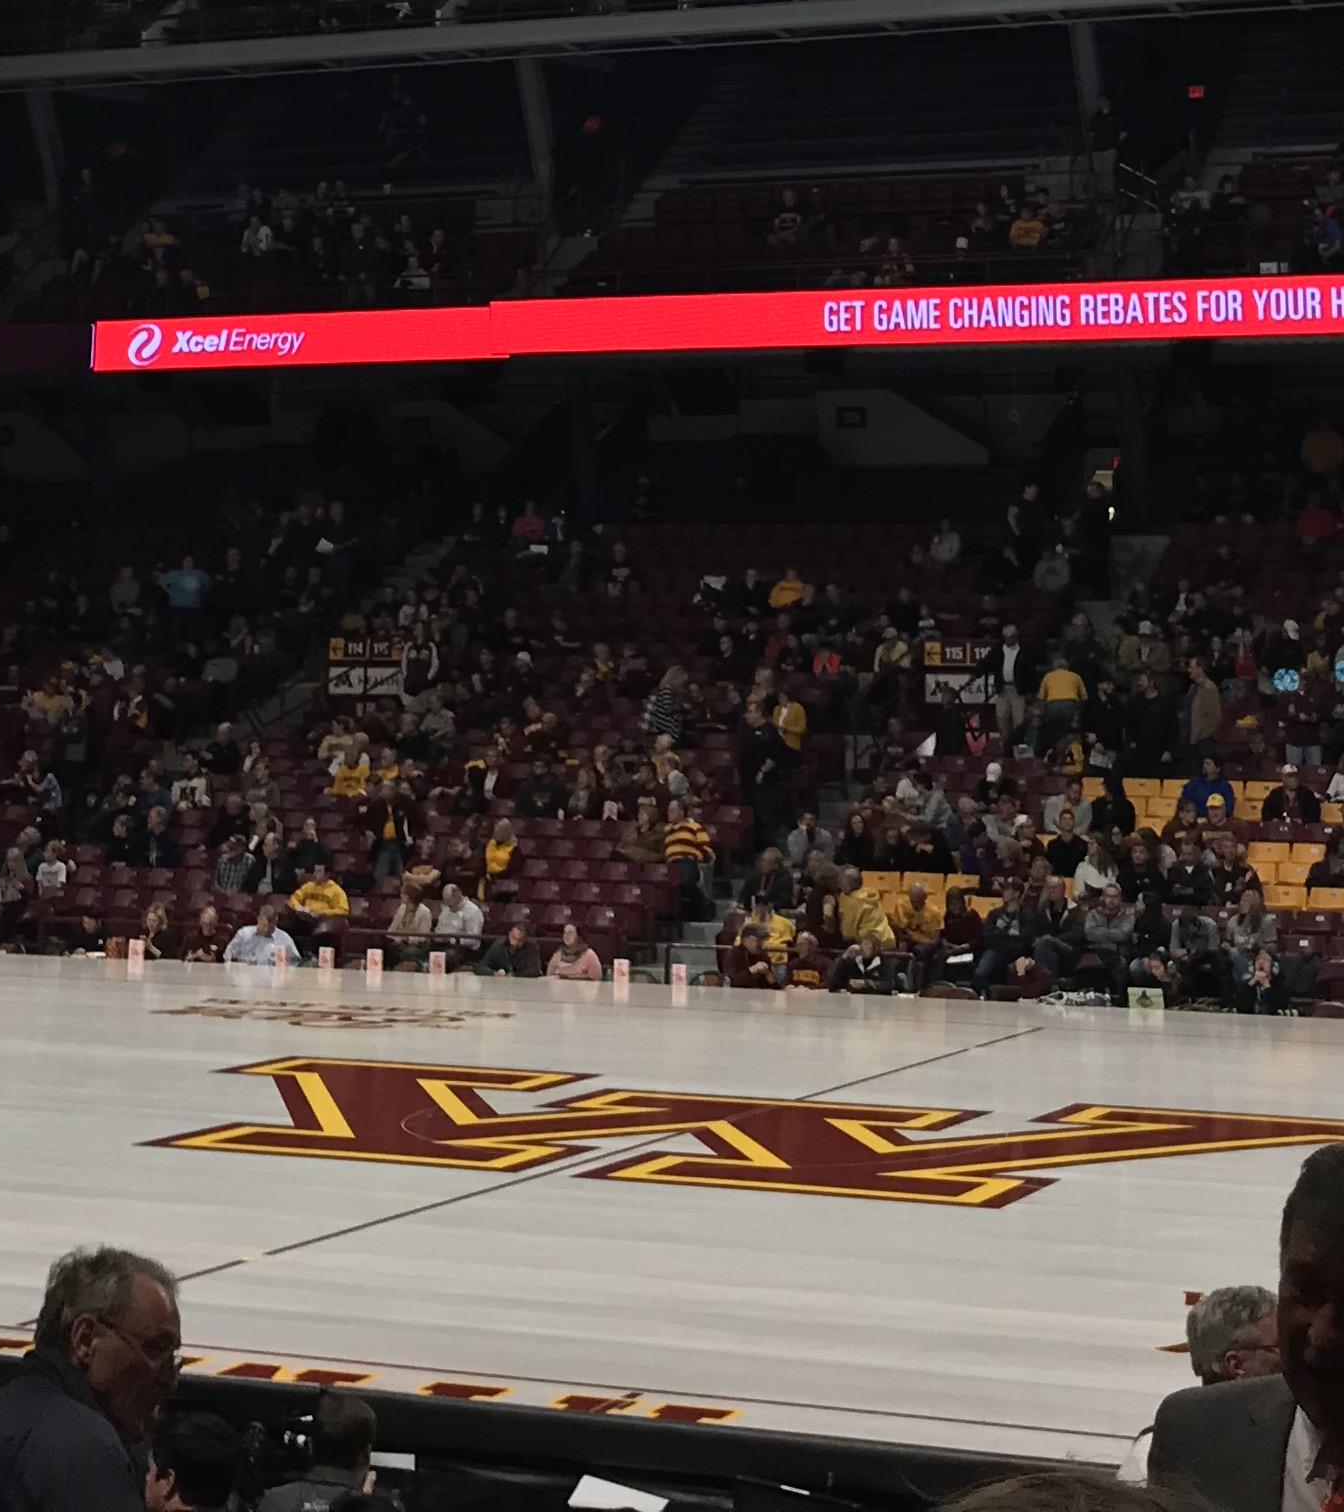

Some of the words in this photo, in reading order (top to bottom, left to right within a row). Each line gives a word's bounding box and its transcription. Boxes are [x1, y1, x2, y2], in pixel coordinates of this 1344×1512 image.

[824, 300, 866, 333] GET
[872, 298, 942, 331] GAME
[948, 294, 1072, 329] CHANGING
[1079, 291, 1189, 325] REBATES
[1196, 289, 1244, 322] FOR
[1252, 286, 1323, 321] YOUR
